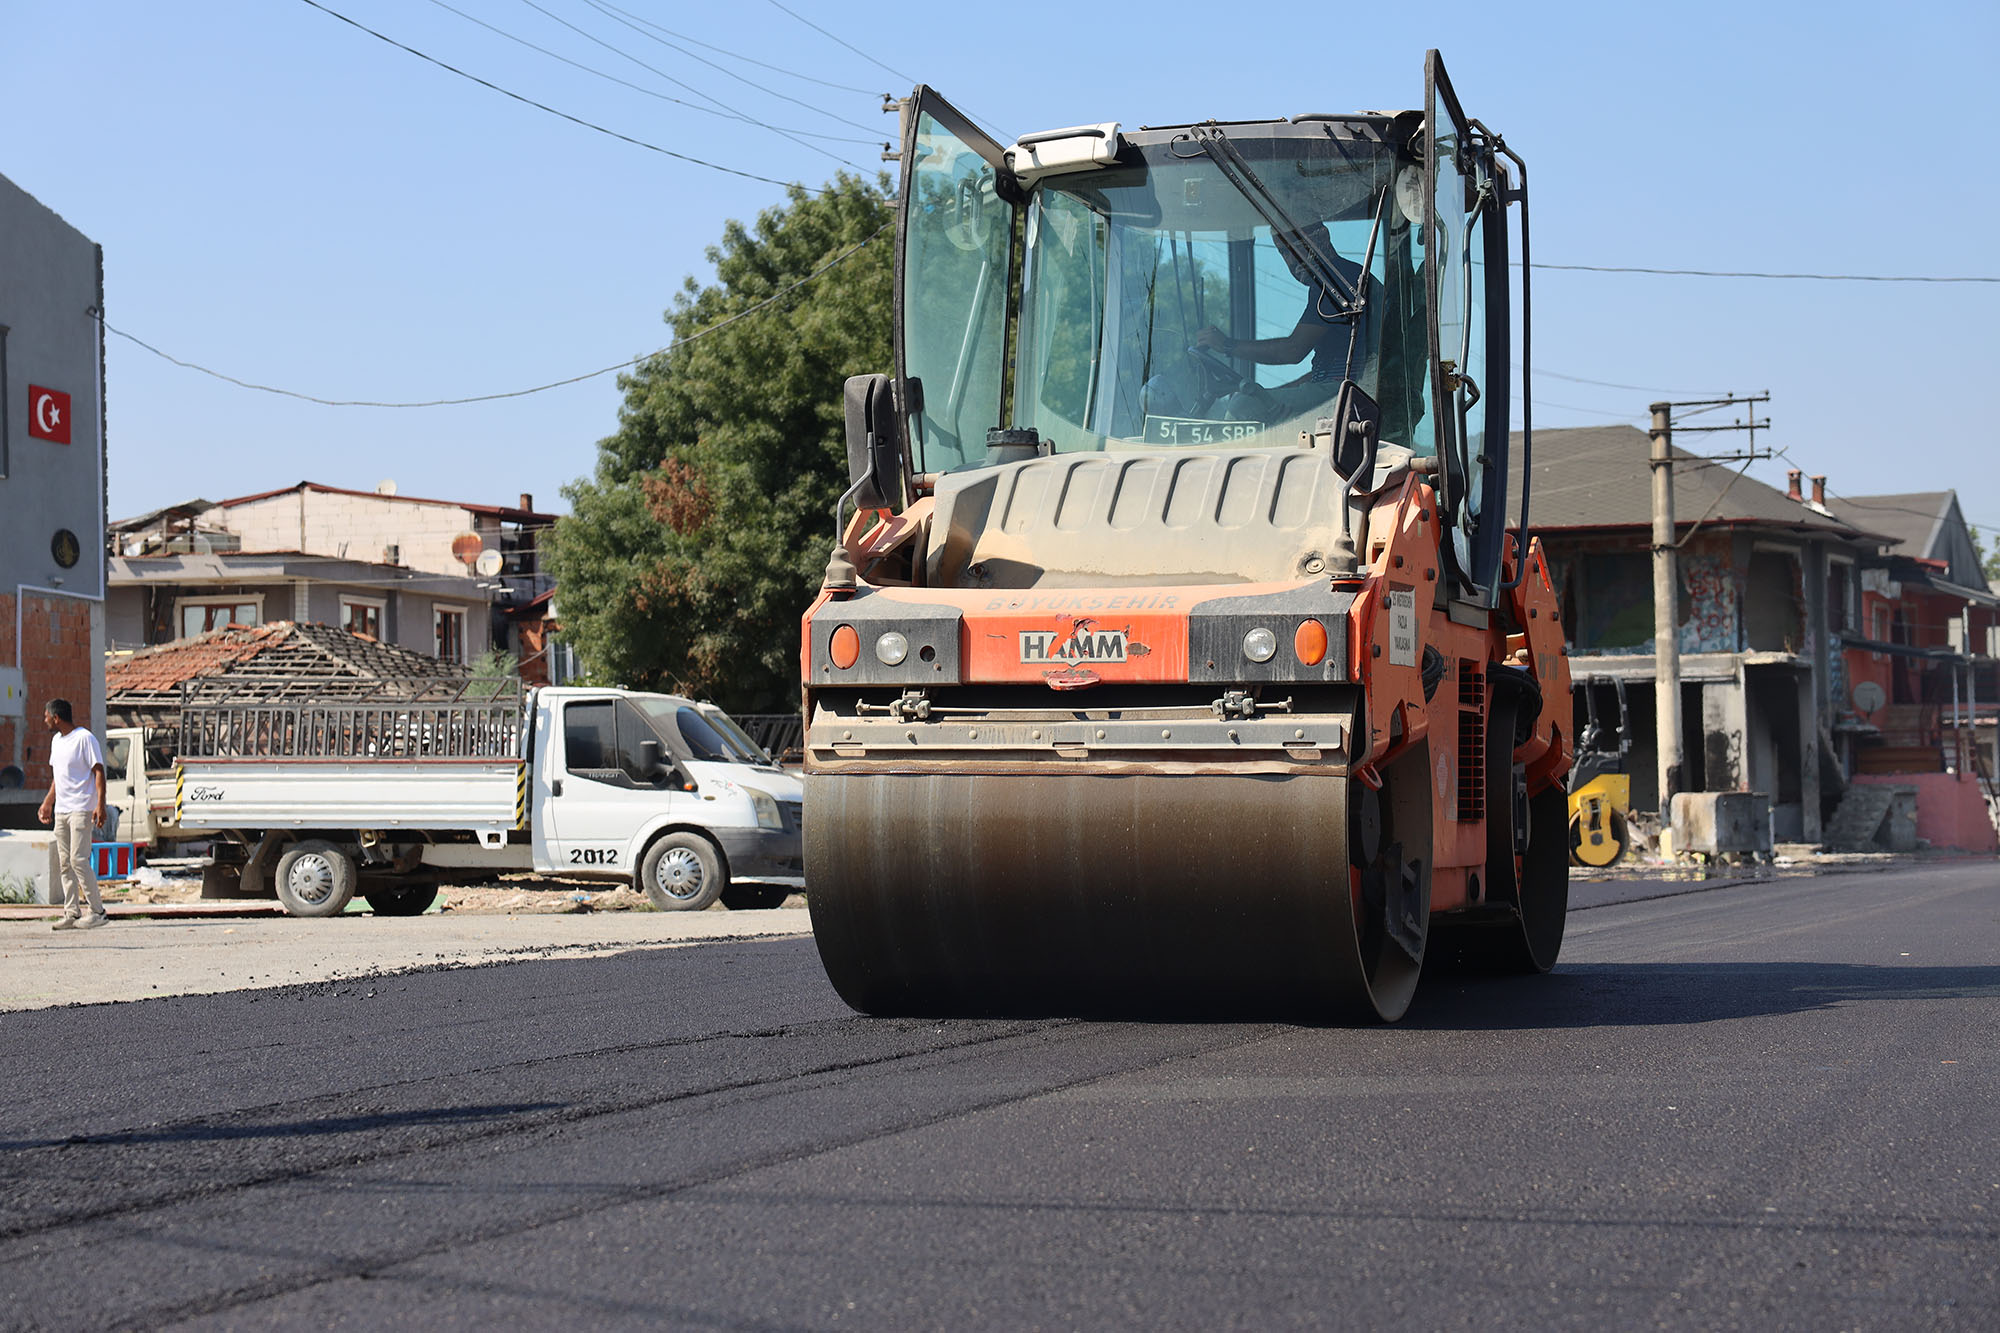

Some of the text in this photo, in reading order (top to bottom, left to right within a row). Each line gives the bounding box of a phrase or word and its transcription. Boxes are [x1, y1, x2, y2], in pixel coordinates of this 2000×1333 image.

[1191, 427, 1214, 444] 54
[983, 592, 1181, 611] BÜYÜKŞEHİR
[1024, 634, 1123, 659] HAMM
[190, 786, 225, 801] Ford
[570, 848, 619, 865] 2012
